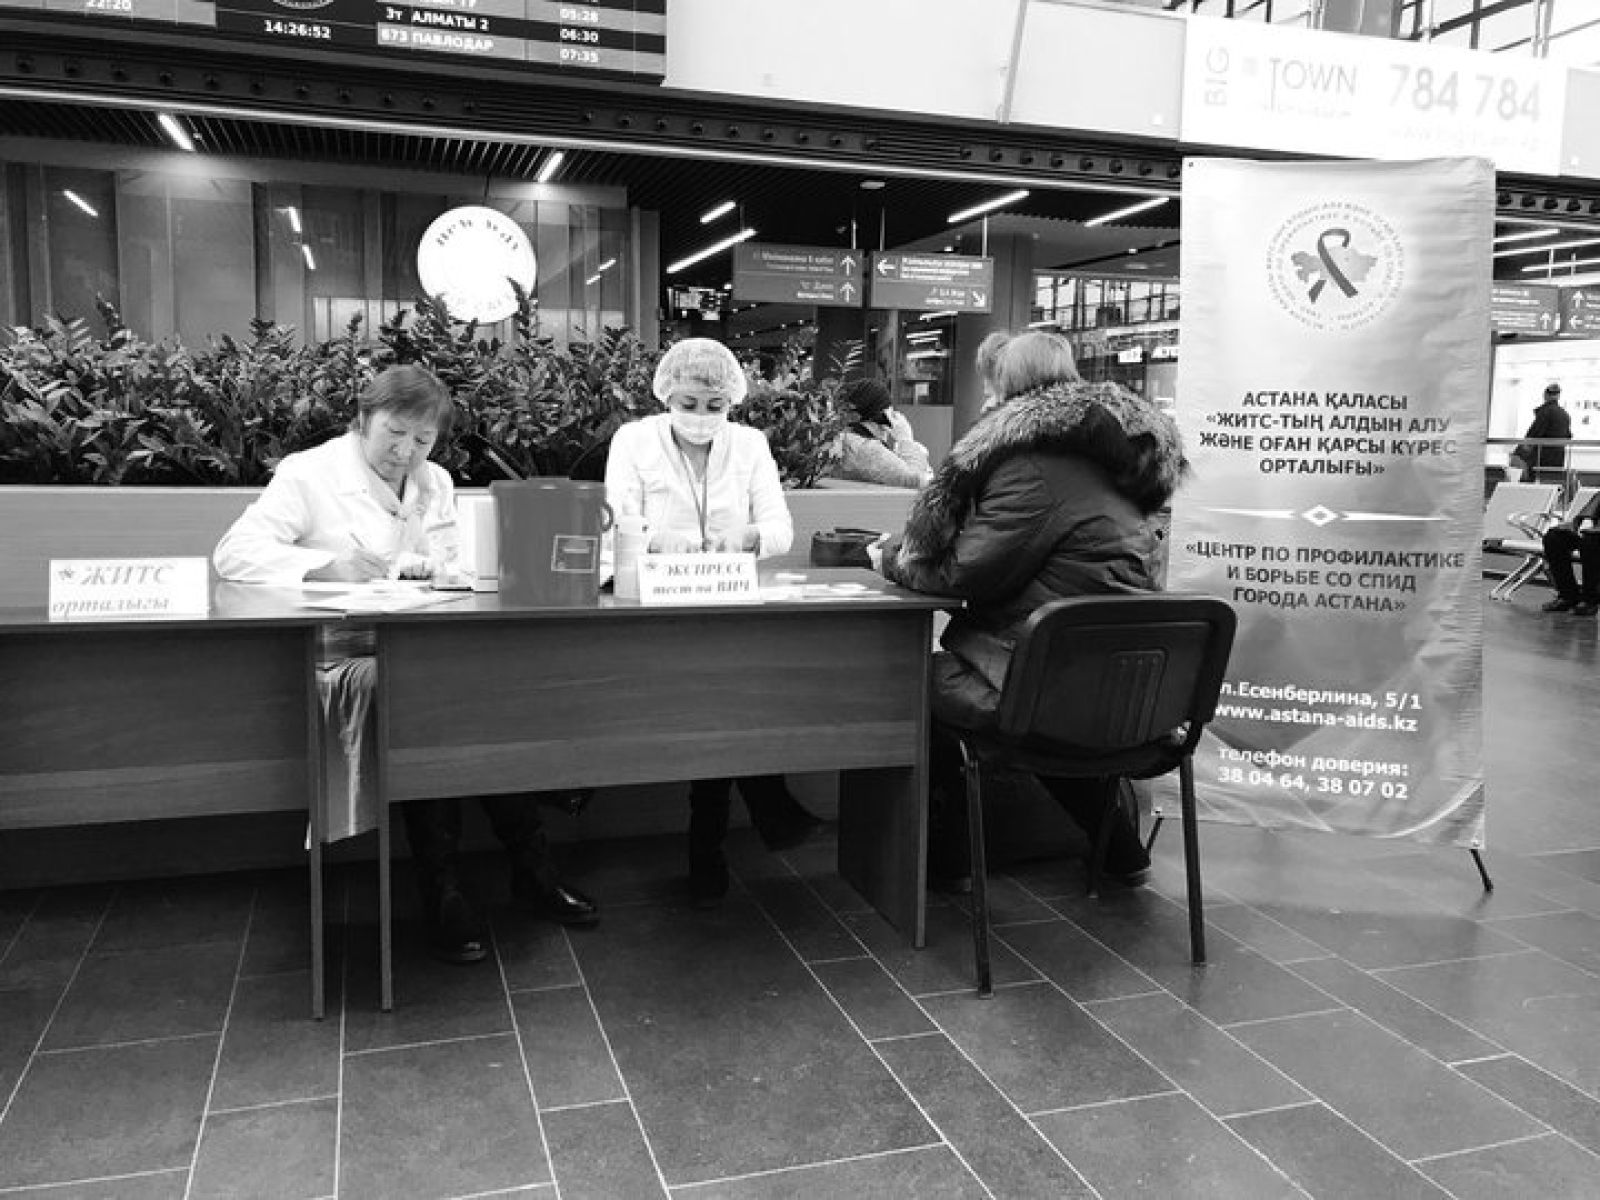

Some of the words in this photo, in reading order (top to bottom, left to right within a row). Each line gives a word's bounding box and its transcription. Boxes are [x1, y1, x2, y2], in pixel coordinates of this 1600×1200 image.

[411, 11, 476, 30] АЛМАТЫ
[412, 32, 494, 51] ПАВЛОДАР
[1204, 46, 1231, 107] BIG
[1268, 57, 1358, 112] TOWN
[1389, 64, 1459, 114] 784
[1475, 74, 1541, 123] 784
[1242, 390, 1319, 408] АСТАНА
[1325, 392, 1407, 411] ҚАЛАСЫ
[1206, 413, 1323, 432] «ЖИТС-ТЫҢ
[1329, 416, 1403, 434] АЛДЫН
[1408, 417, 1451, 434] АЛУ
[1199, 431, 1254, 450] ЖӘНЕ
[1259, 436, 1311, 452] ОҒАН
[1317, 437, 1386, 456] ҚАРСЫ
[1390, 439, 1457, 456] КҮРЕС
[1259, 459, 1386, 475] ОРТАЛЫҒЫ»
[1186, 541, 1257, 561] «ЦЕНТР
[1261, 546, 1290, 563] ПО
[1297, 548, 1466, 568] ПРОФИЛАКТИКЕ
[80, 565, 176, 586] ЖИТС
[1227, 565, 1240, 580] И
[1245, 567, 1320, 585] БОРЬБЕ
[1326, 572, 1352, 587] СО
[1358, 573, 1417, 592] СПИД
[1232, 586, 1309, 609] ГОРОДА
[1315, 592, 1407, 612] АСТАНА»
[1219, 681, 1379, 709] л.Есенберлина,
[1385, 692, 1423, 711] 5/1
[1215, 703, 1420, 732] www.astana-aids.kz
[1218, 748, 1307, 769] телефон
[1311, 756, 1410, 777] доверия:
[1218, 766, 1243, 783] 38
[1249, 770, 1274, 787] 04
[1280, 773, 1310, 793] 64,
[1317, 777, 1343, 794] 38
[1349, 779, 1375, 797] 07
[1381, 783, 1409, 800] 02
